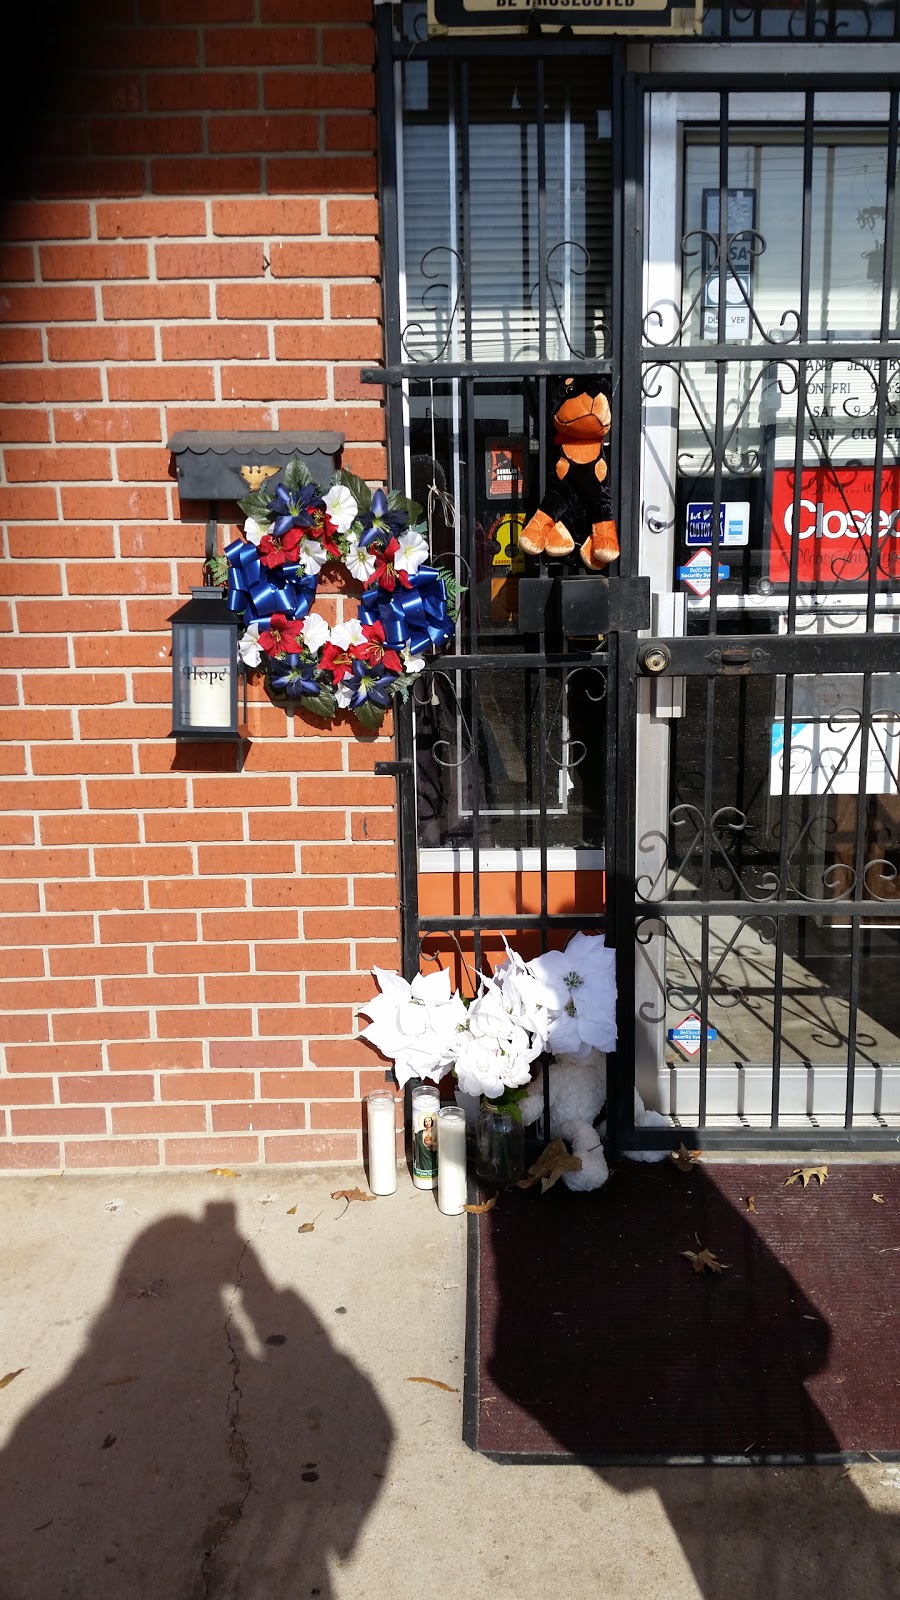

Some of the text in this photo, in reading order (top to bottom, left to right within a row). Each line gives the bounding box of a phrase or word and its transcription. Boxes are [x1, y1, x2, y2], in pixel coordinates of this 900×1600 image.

[708, 316, 745, 324] DISVER
[813, 405, 836, 418] SAT
[808, 428, 900, 440] SUN CLOED
